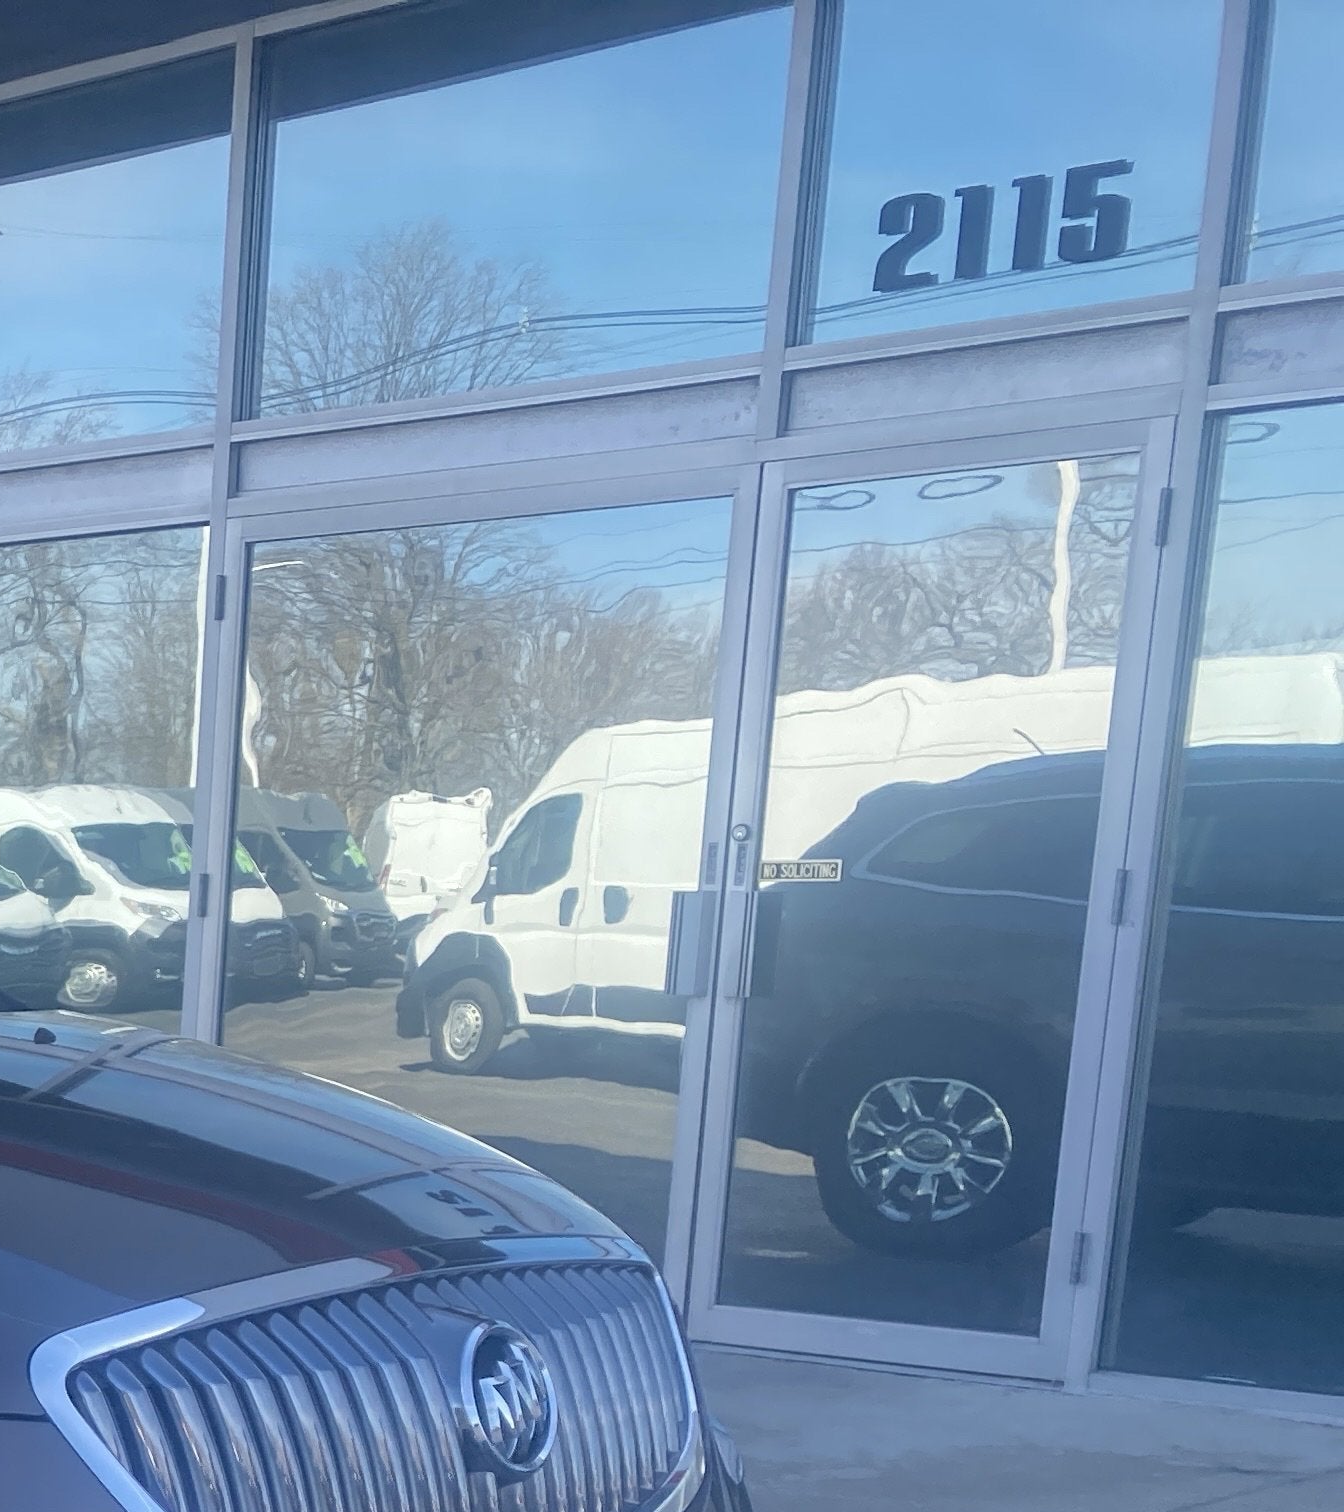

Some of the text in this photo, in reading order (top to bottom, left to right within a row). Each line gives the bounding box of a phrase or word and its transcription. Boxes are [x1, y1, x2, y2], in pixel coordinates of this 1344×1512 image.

[872, 159, 1135, 293] 2115
[764, 864, 836, 878] NO SOLICITING
